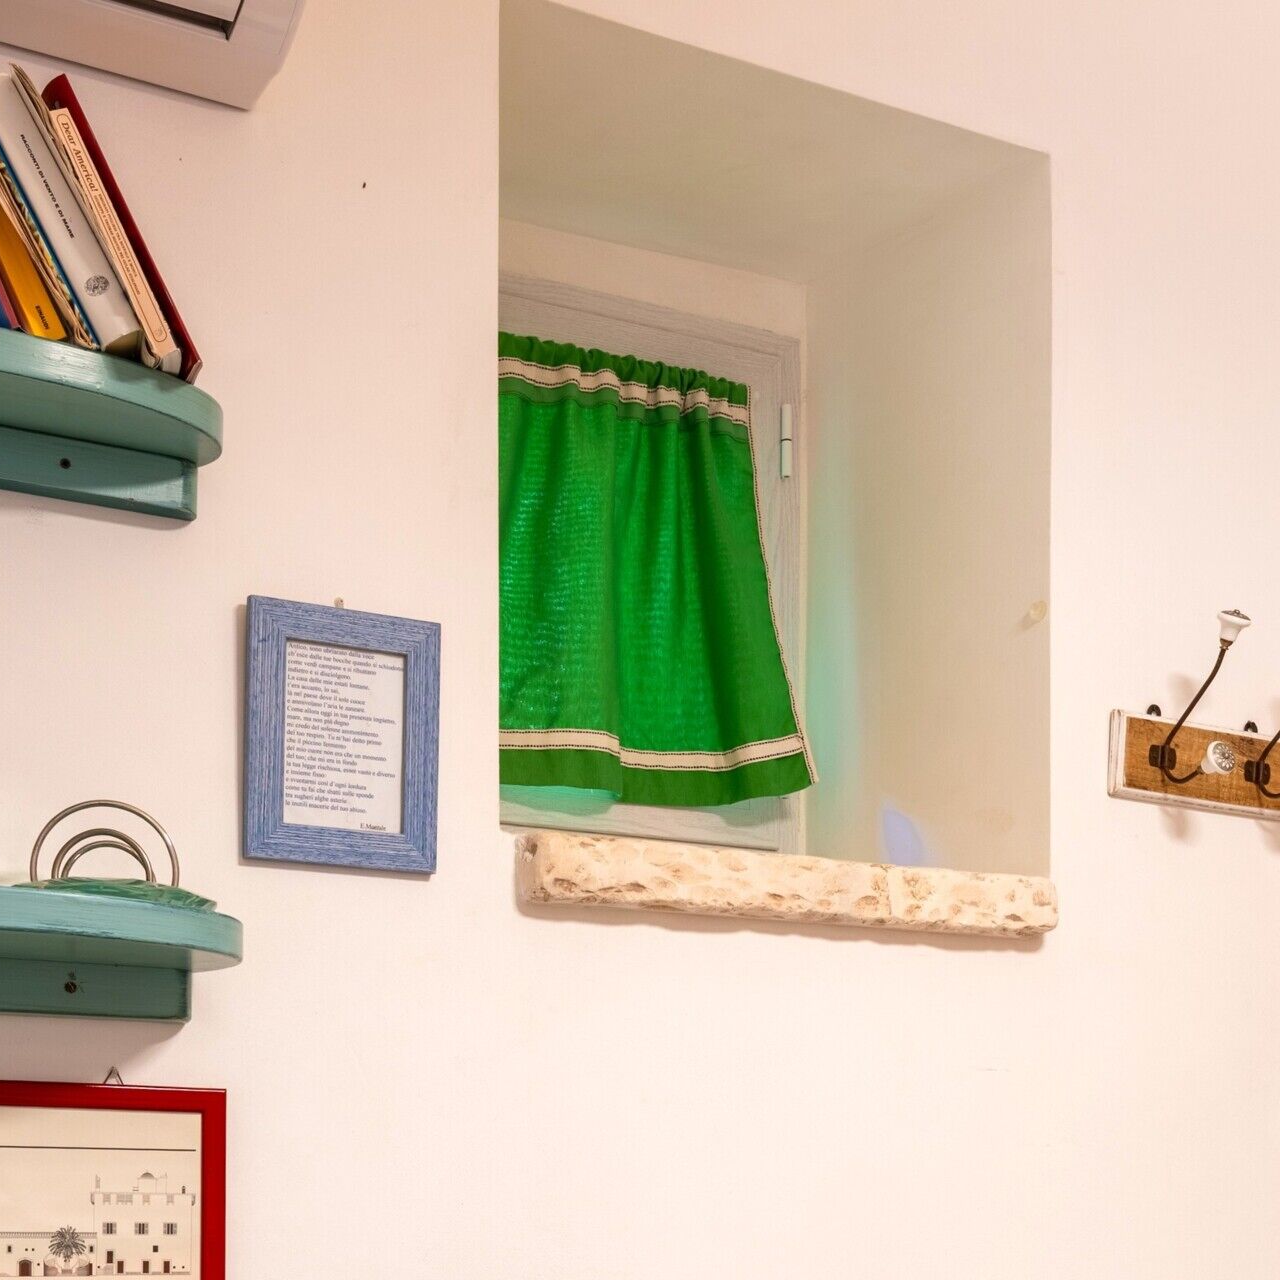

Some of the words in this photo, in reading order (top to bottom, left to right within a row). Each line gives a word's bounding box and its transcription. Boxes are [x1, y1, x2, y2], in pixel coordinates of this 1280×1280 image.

[19, 134, 41, 169] RACCONTI
[37, 170, 45, 178] DI
[41, 179, 56, 201] VENTO
[61, 218, 74, 238] MARE
[60, 122, 78, 145] Dear
[71, 148, 99, 191] America!
[34, 305, 50, 329] EINAUDI
